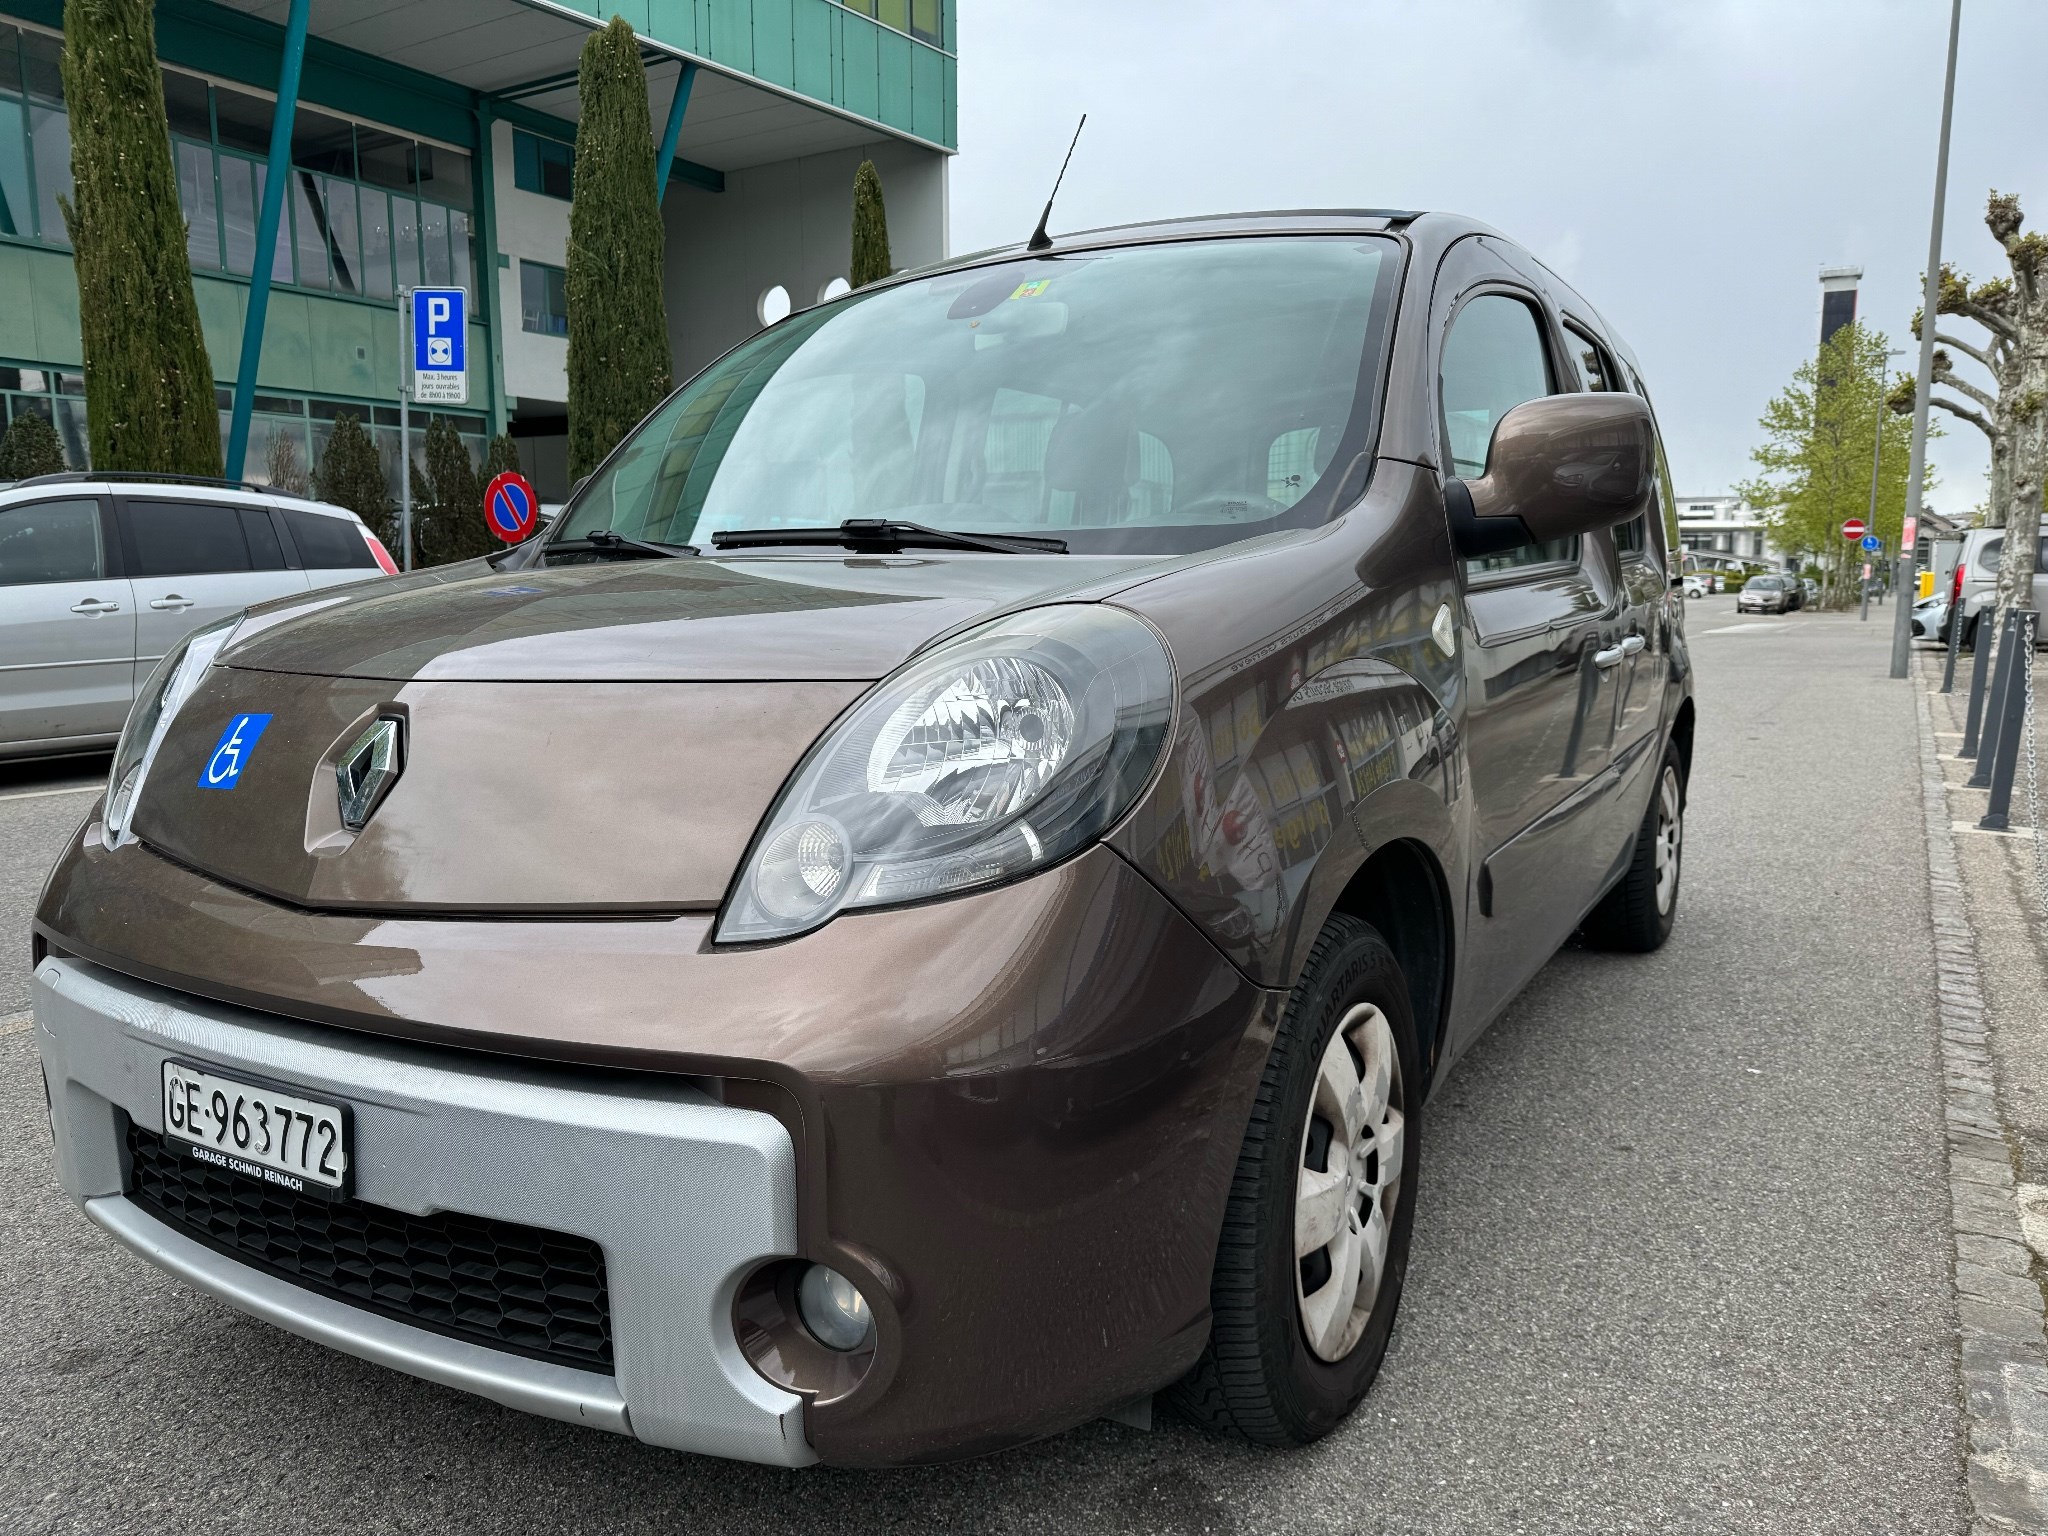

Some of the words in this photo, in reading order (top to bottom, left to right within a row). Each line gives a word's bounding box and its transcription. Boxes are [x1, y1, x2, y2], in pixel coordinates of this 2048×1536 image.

[427, 297, 450, 335] P
[421, 382, 434, 390] jours
[192, 1147, 227, 1166] GARAGE
[229, 1158, 262, 1177] SCHMID
[264, 1169, 303, 1191] REINACH
